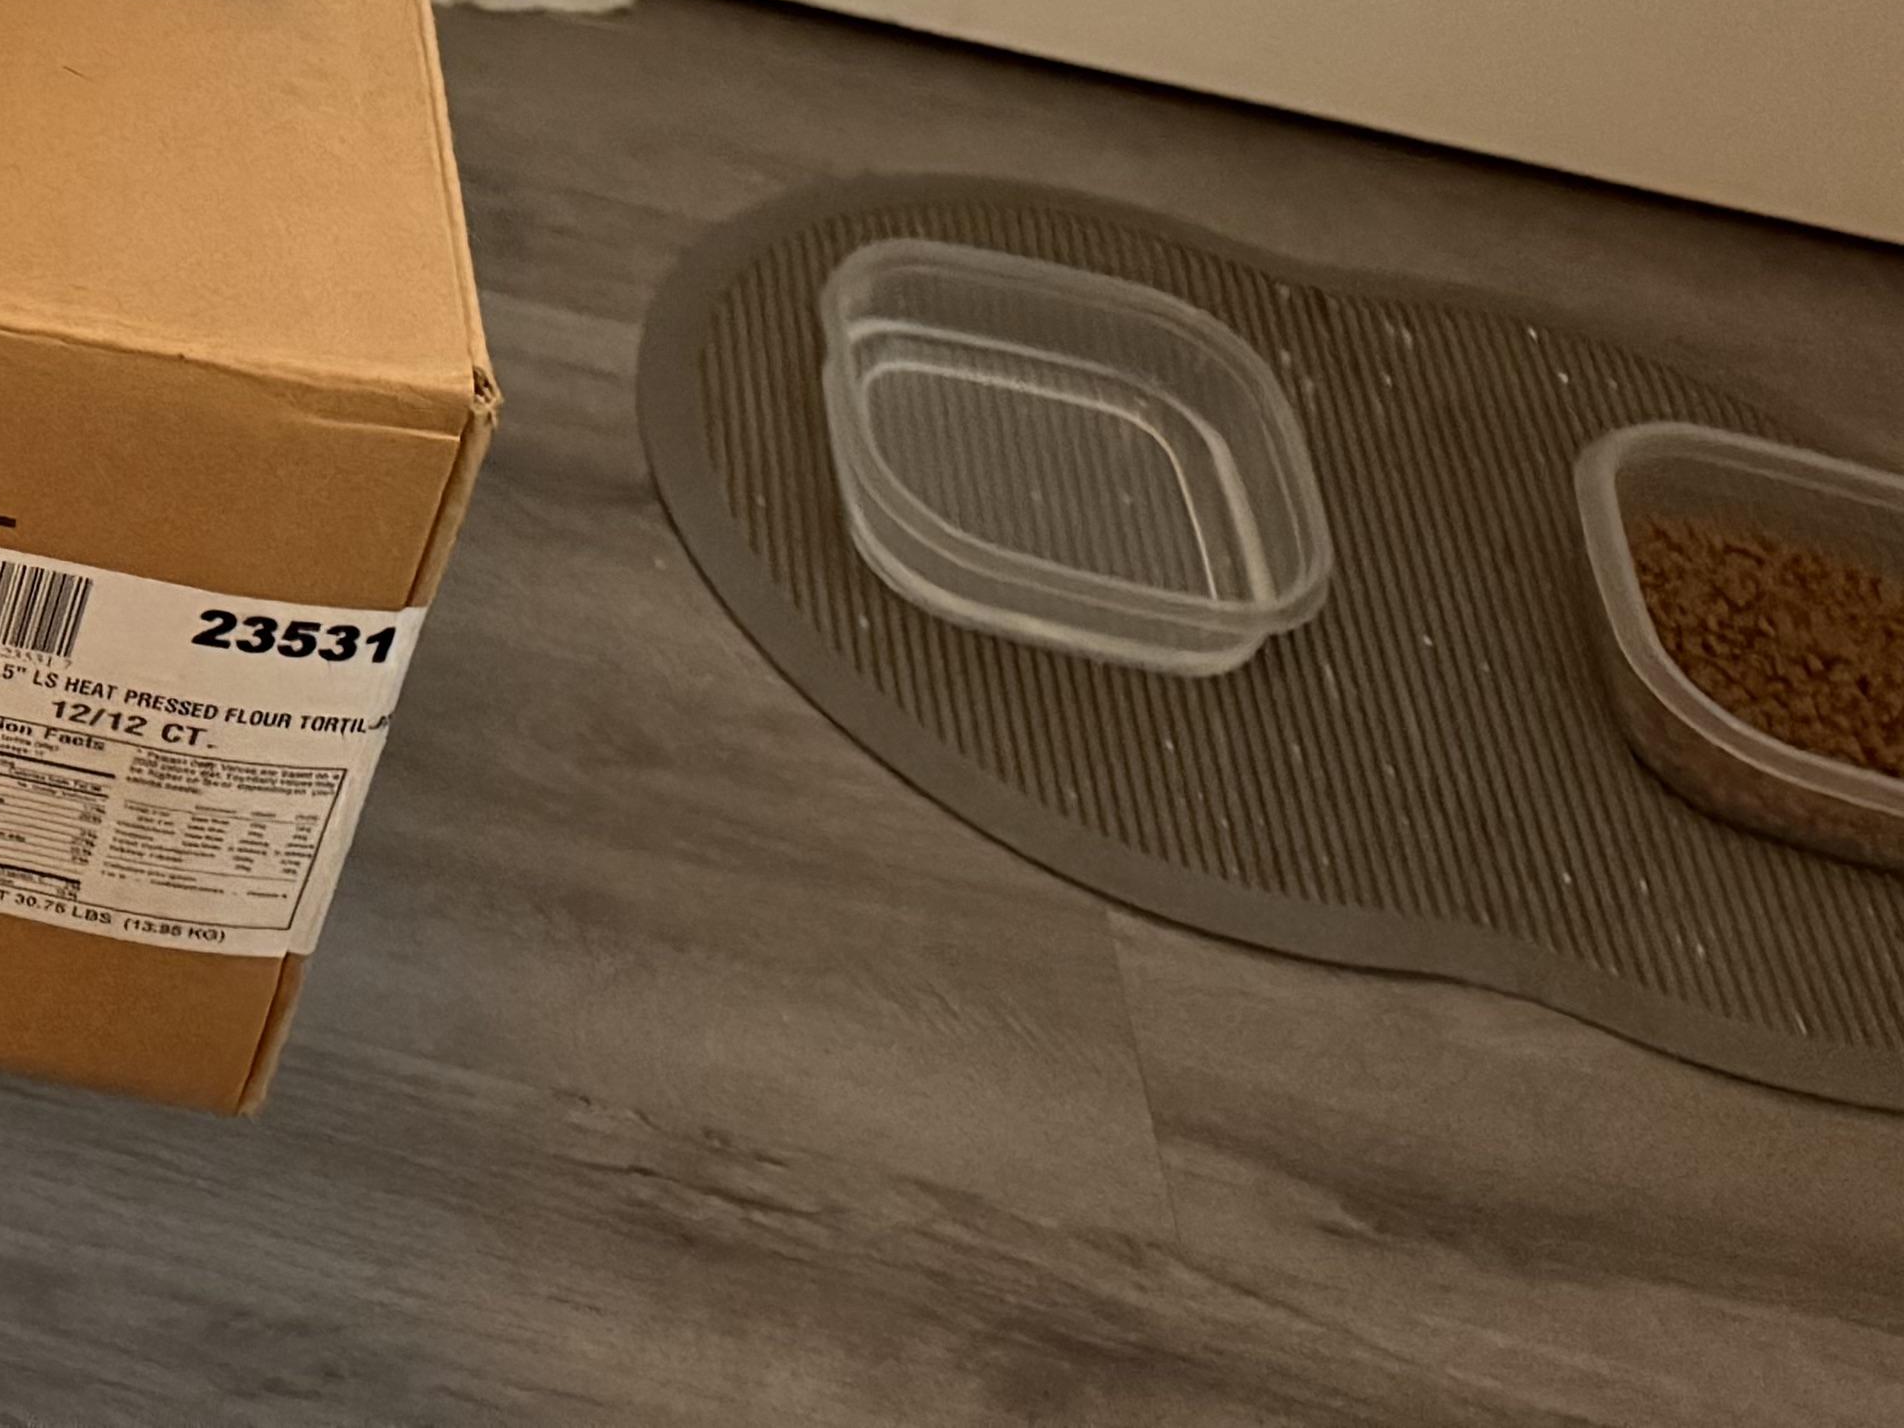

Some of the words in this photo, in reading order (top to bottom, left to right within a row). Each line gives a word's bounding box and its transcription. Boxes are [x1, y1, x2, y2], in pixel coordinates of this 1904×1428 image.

[191, 608, 397, 664] 23531
[32, 669, 59, 689] LS
[63, 676, 119, 701] HEAT
[123, 689, 220, 722] PRESSED
[224, 707, 293, 730] FLOUR
[51, 699, 149, 738] 12/12
[160, 722, 219, 750] CT.
[42, 726, 107, 752] Facts
[71, 905, 113, 926] LBS
